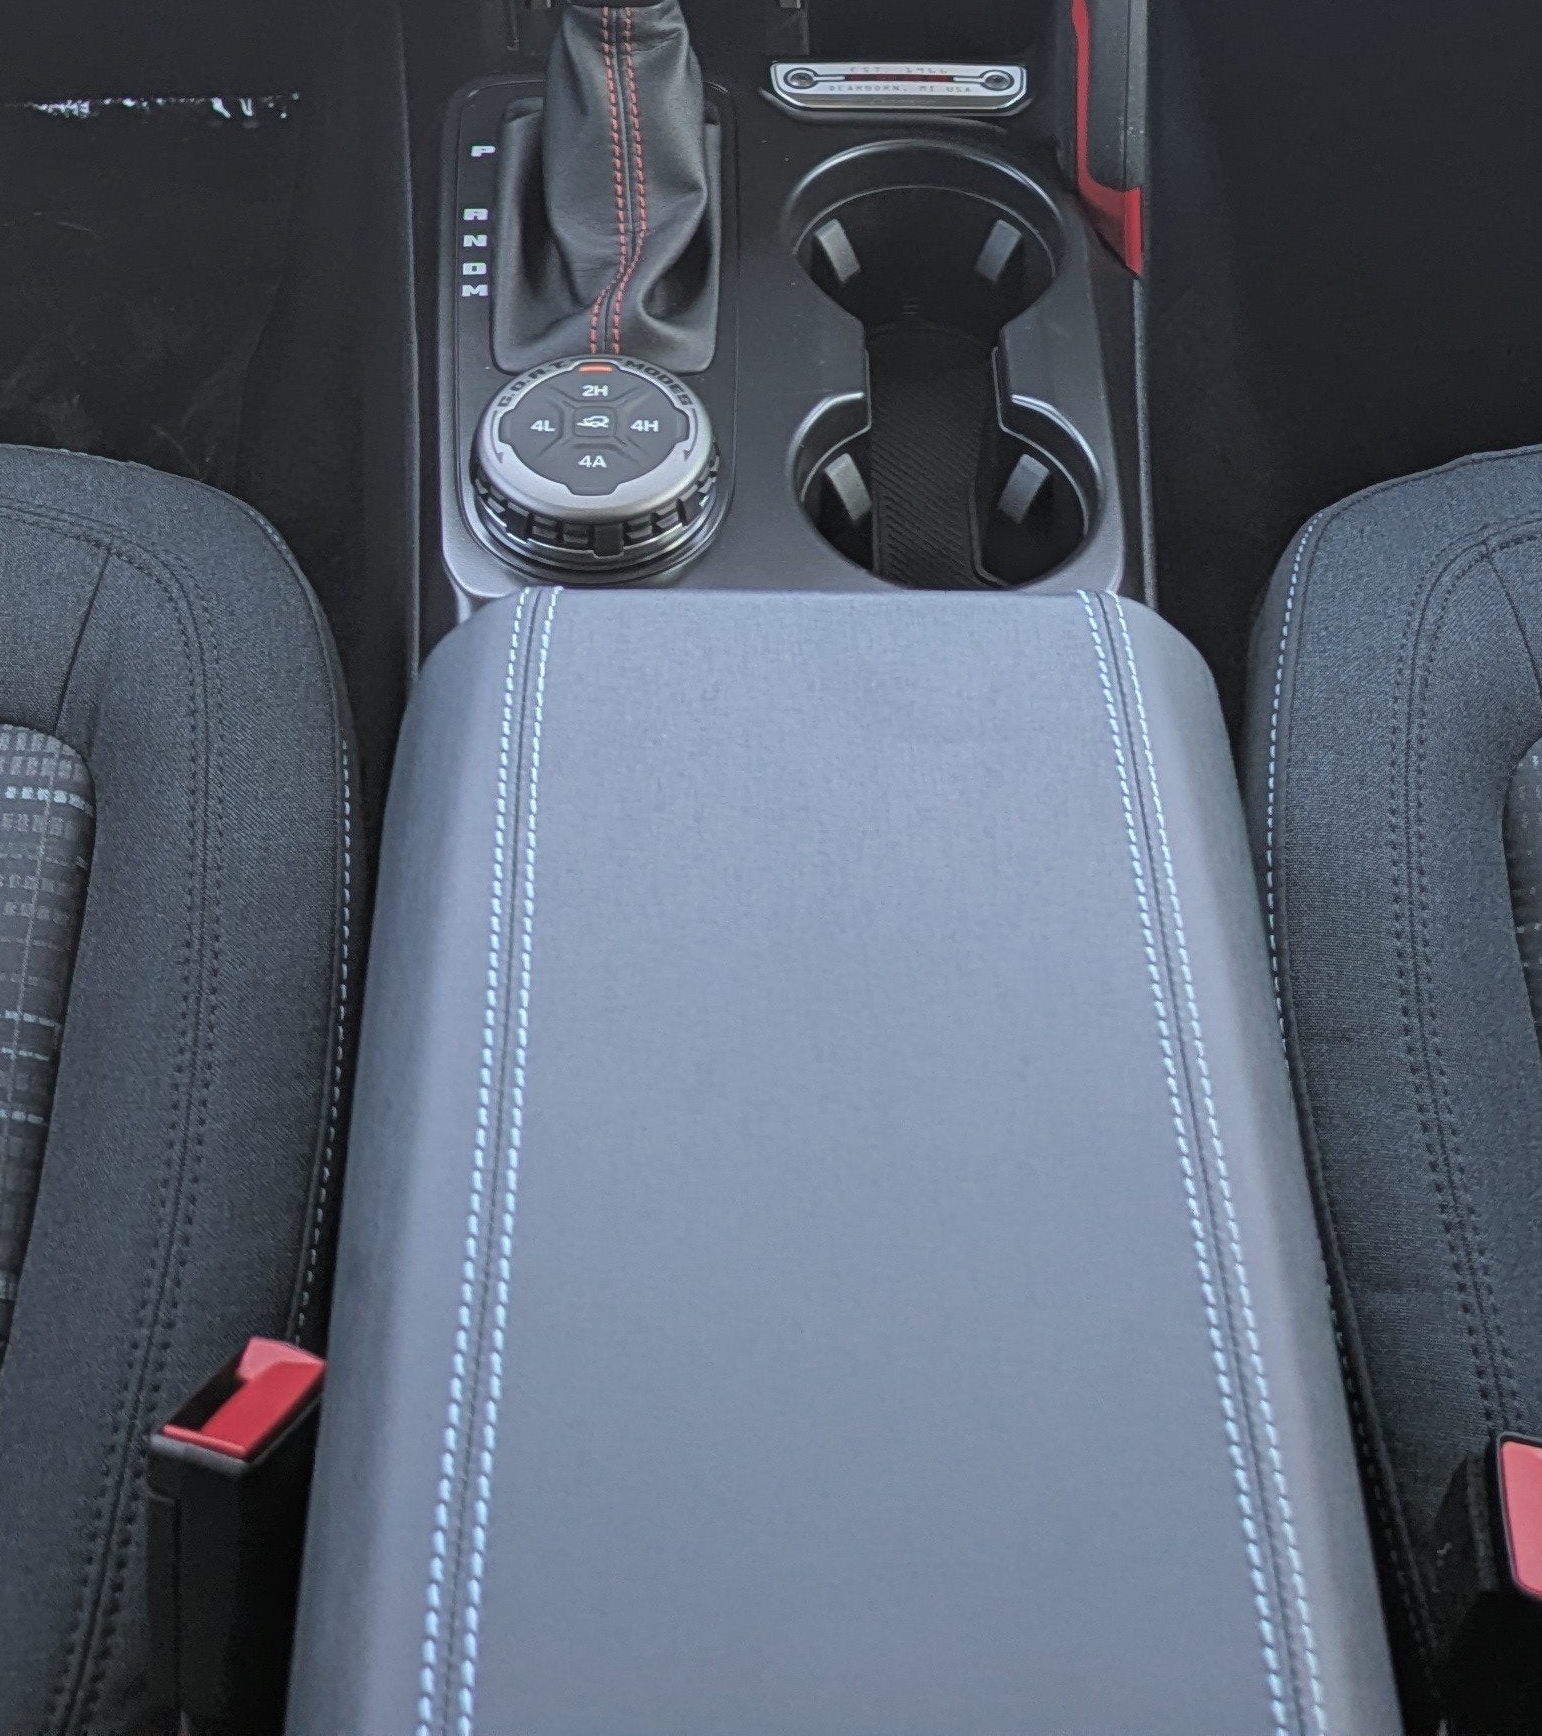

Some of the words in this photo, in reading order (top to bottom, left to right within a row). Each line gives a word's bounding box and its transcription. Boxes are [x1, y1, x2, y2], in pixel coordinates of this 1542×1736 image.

[471, 145, 496, 157] P
[463, 208, 488, 221] R
[463, 234, 488, 247] N
[462, 262, 487, 275] D
[461, 284, 489, 297] M
[624, 360, 695, 407] MODES
[581, 384, 609, 397] 2H
[530, 419, 556, 432] 4L
[630, 419, 660, 432] 4H
[577, 455, 607, 468] 4A
